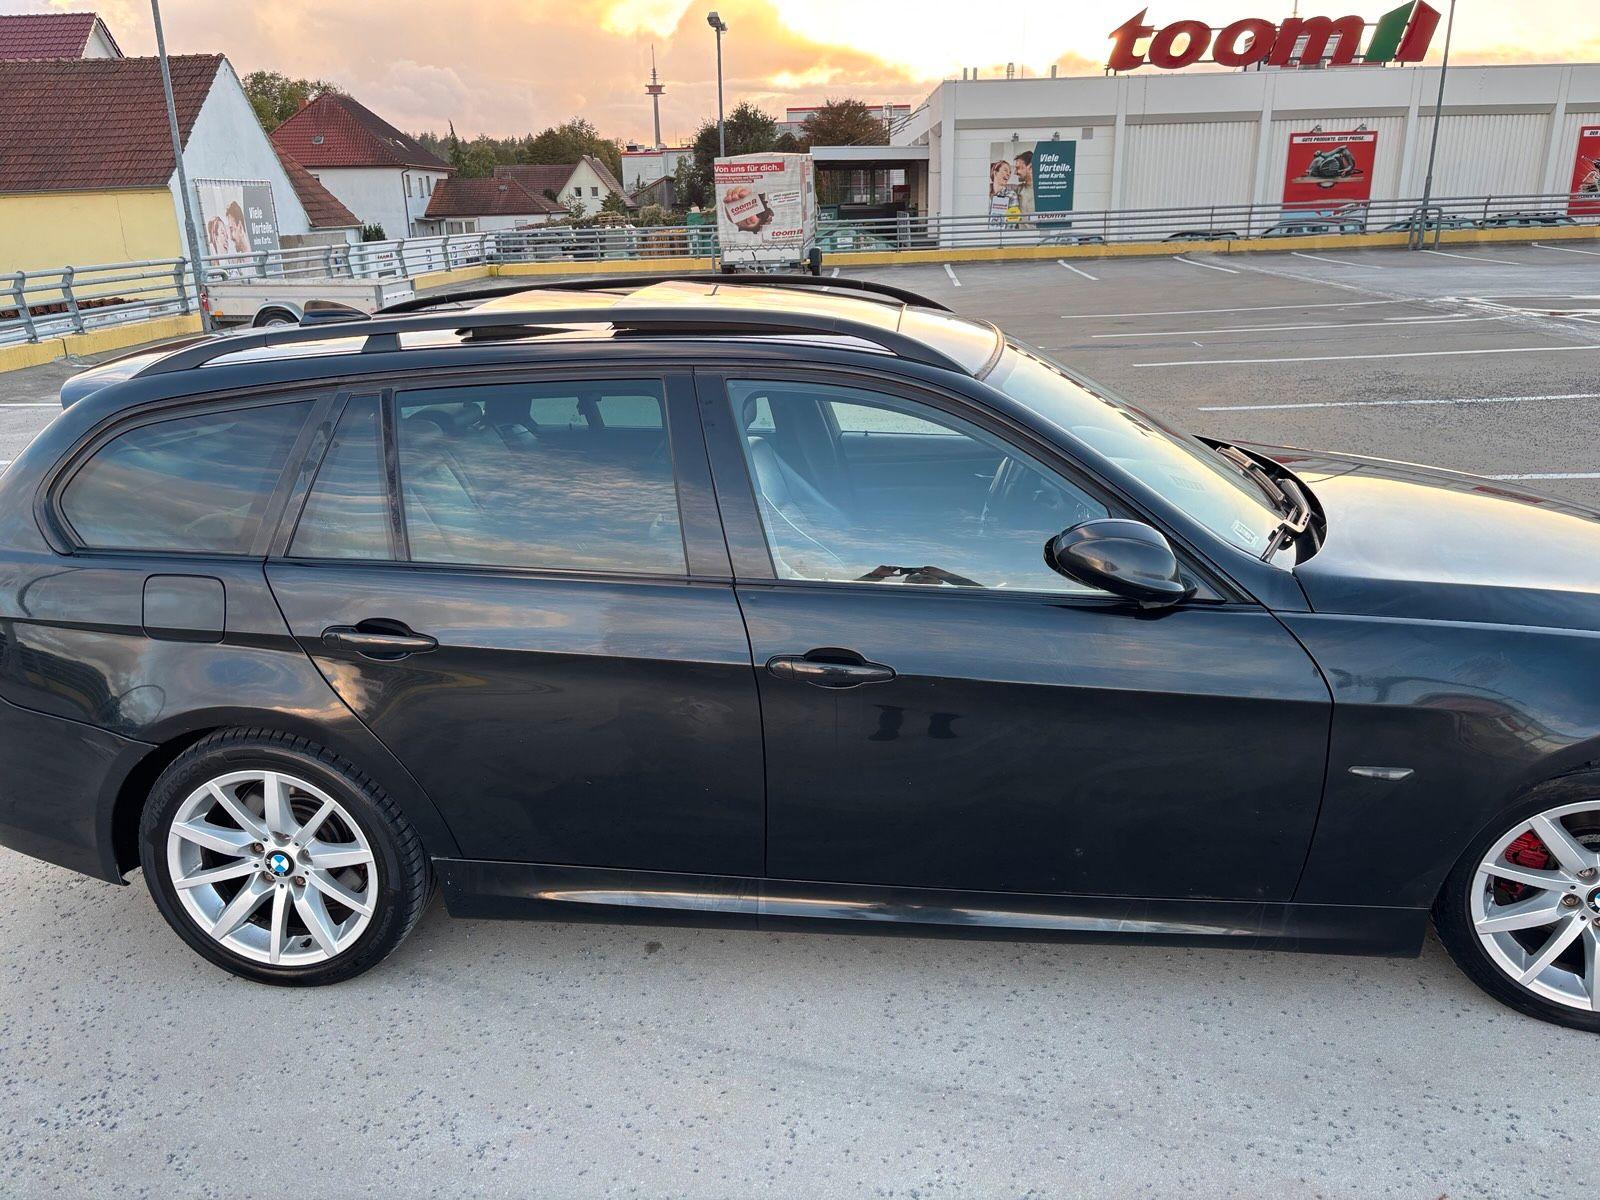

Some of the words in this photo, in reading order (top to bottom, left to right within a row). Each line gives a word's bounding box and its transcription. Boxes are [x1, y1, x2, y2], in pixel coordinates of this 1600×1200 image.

[1108, 6, 1365, 71] toom
[1040, 153, 1060, 162] Viele
[248, 207, 263, 219] Viele
[731, 201, 752, 213] toom
[771, 229, 797, 237] toom
